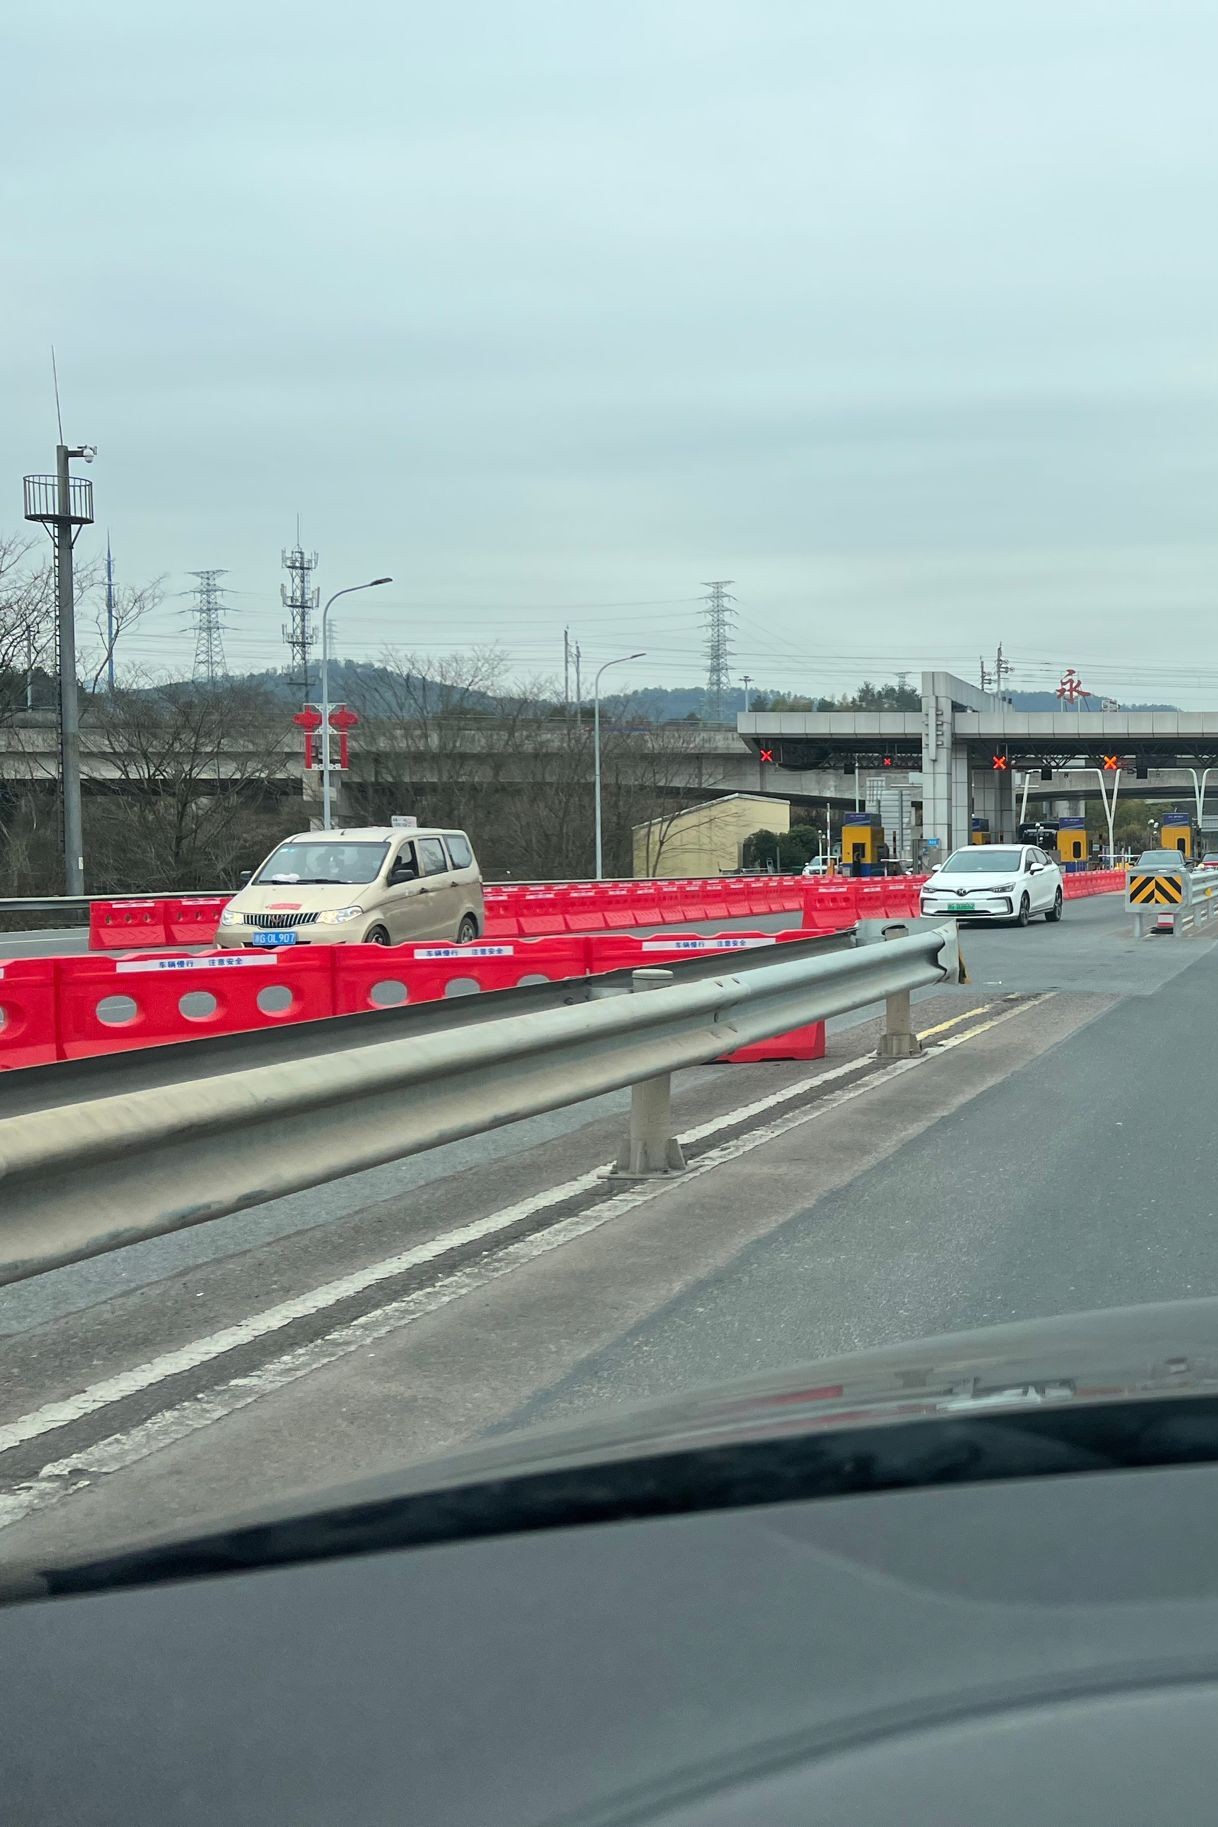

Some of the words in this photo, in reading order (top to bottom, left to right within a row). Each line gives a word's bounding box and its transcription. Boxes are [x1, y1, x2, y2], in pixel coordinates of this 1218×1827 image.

[1056, 669, 1091, 704] 永
[159, 960, 194, 970] 车辆慢行
[208, 957, 243, 967] 注意安全
